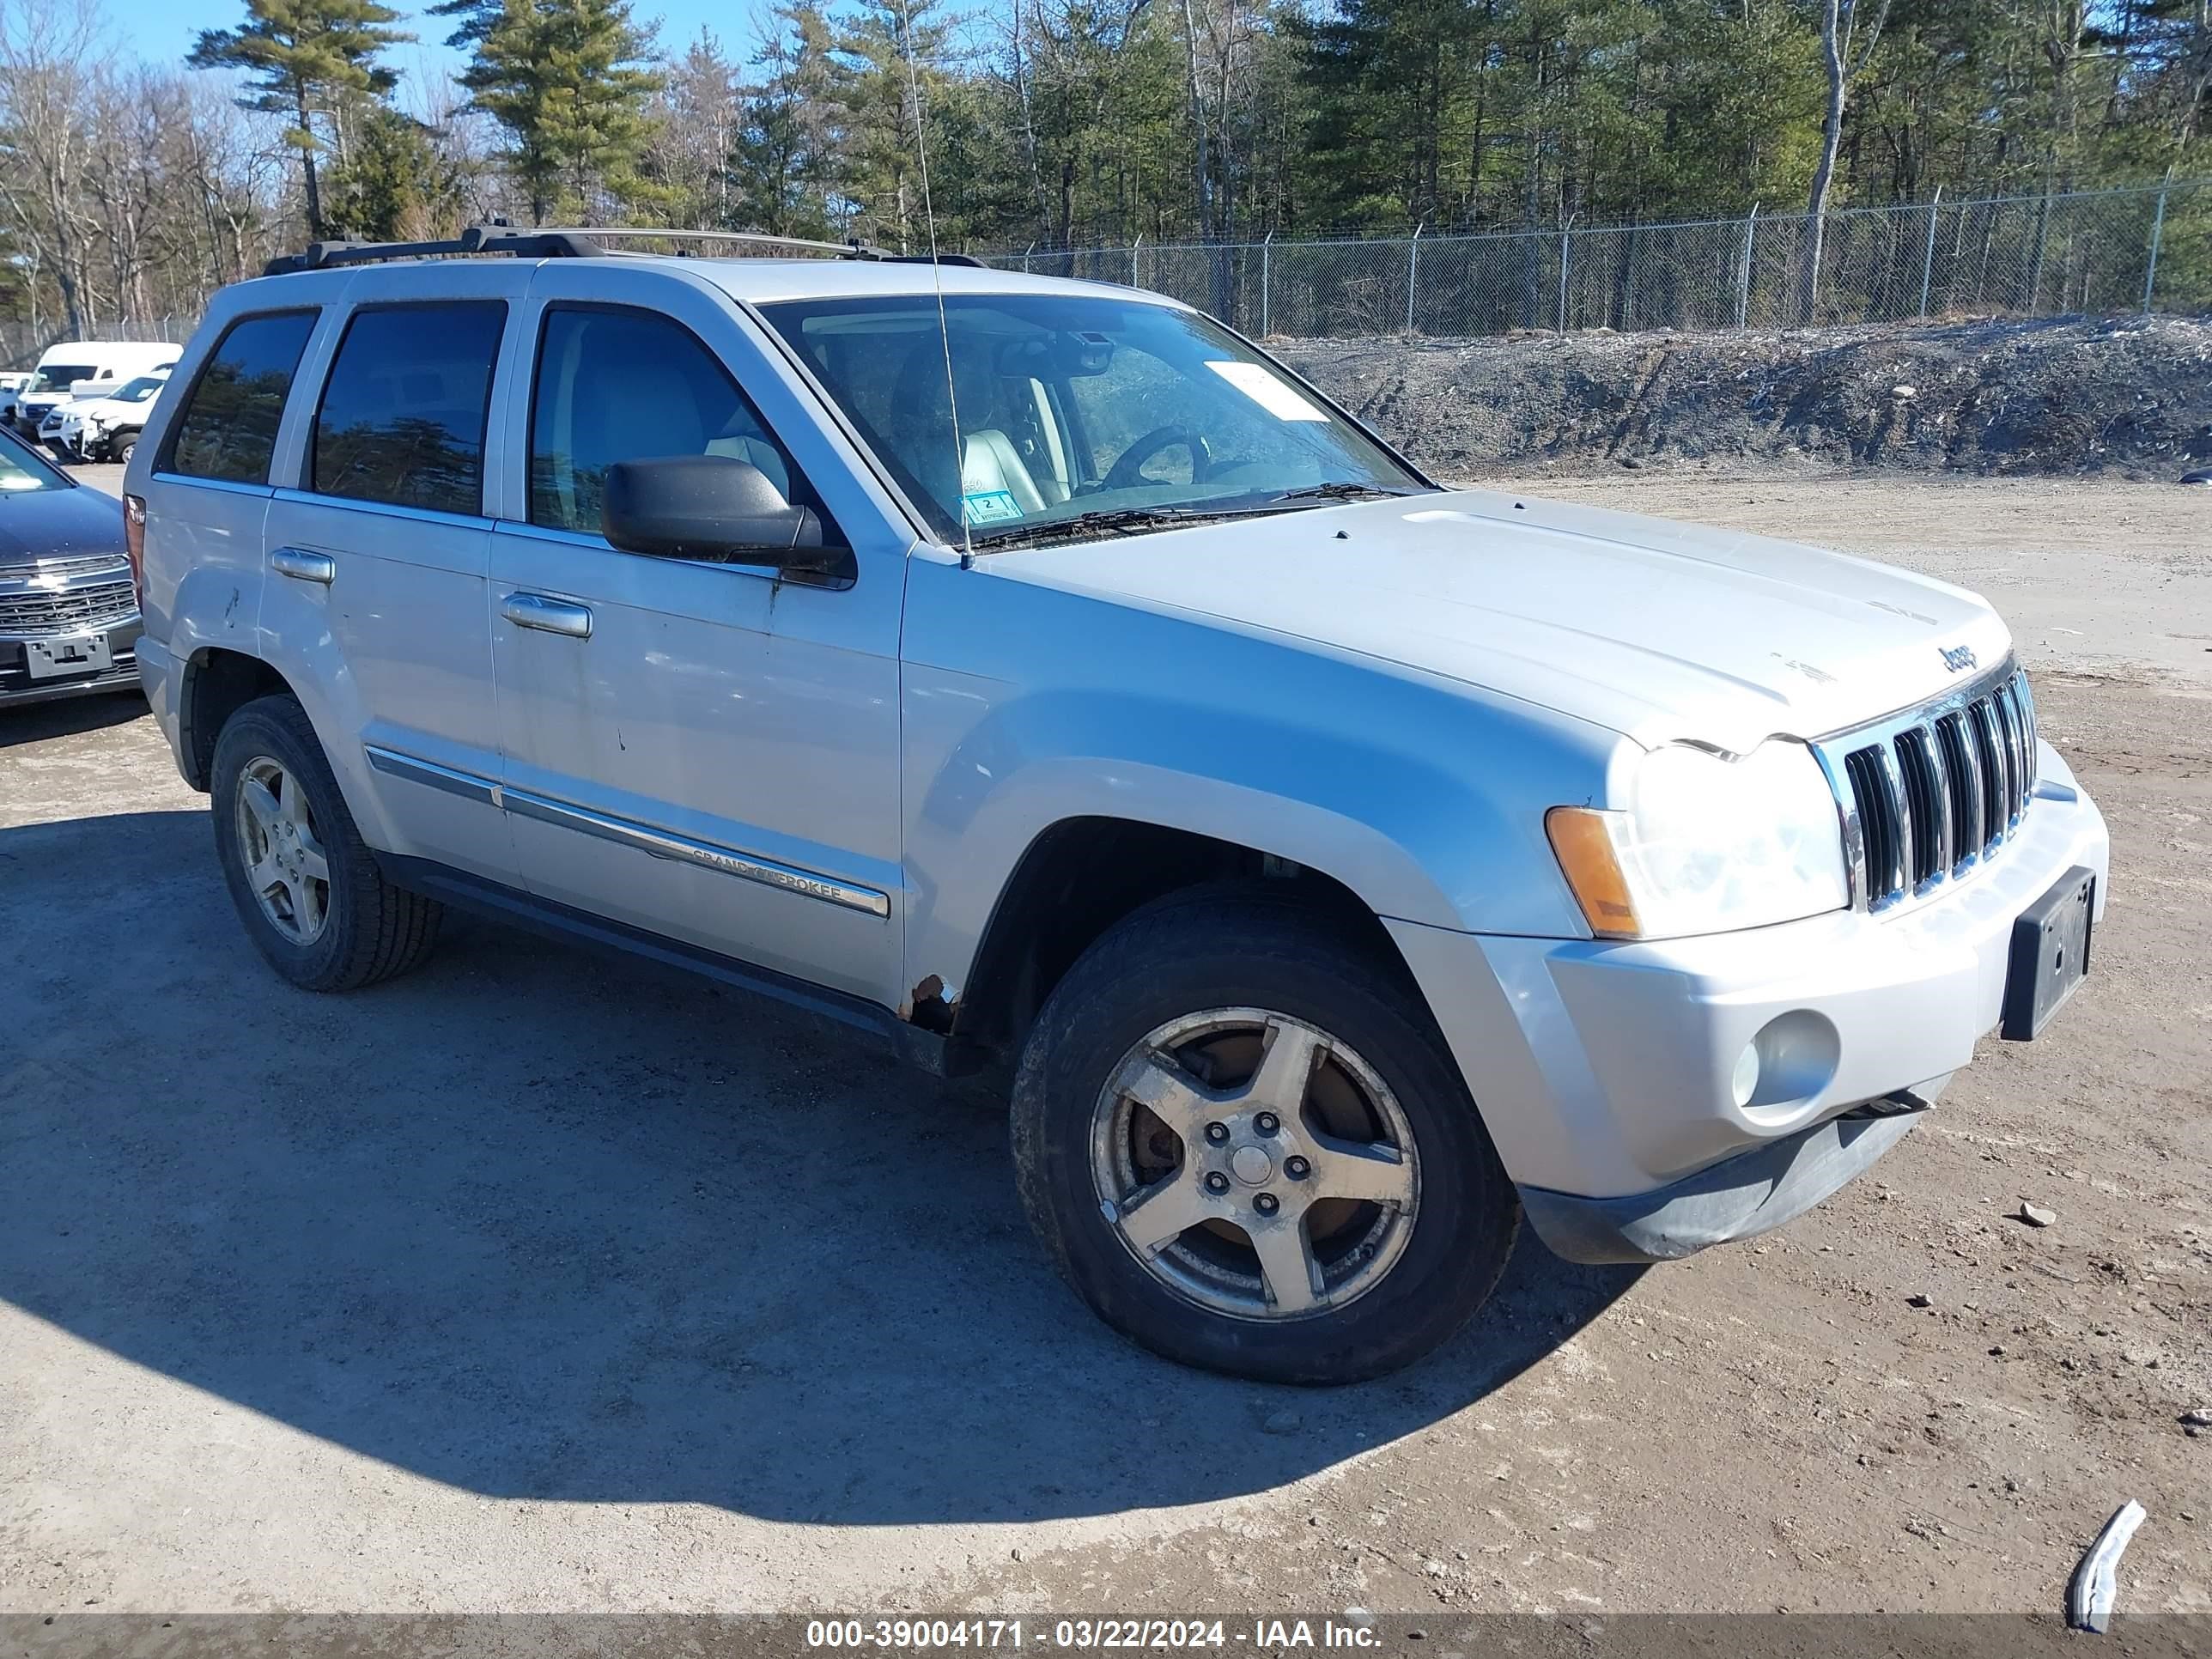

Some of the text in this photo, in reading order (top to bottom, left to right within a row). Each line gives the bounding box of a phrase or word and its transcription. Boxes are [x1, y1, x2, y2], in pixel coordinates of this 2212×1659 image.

[982, 499, 994, 508] 2
[1937, 645, 1978, 673] Jeep
[692, 849, 842, 899] GRAND CHEROKEE
